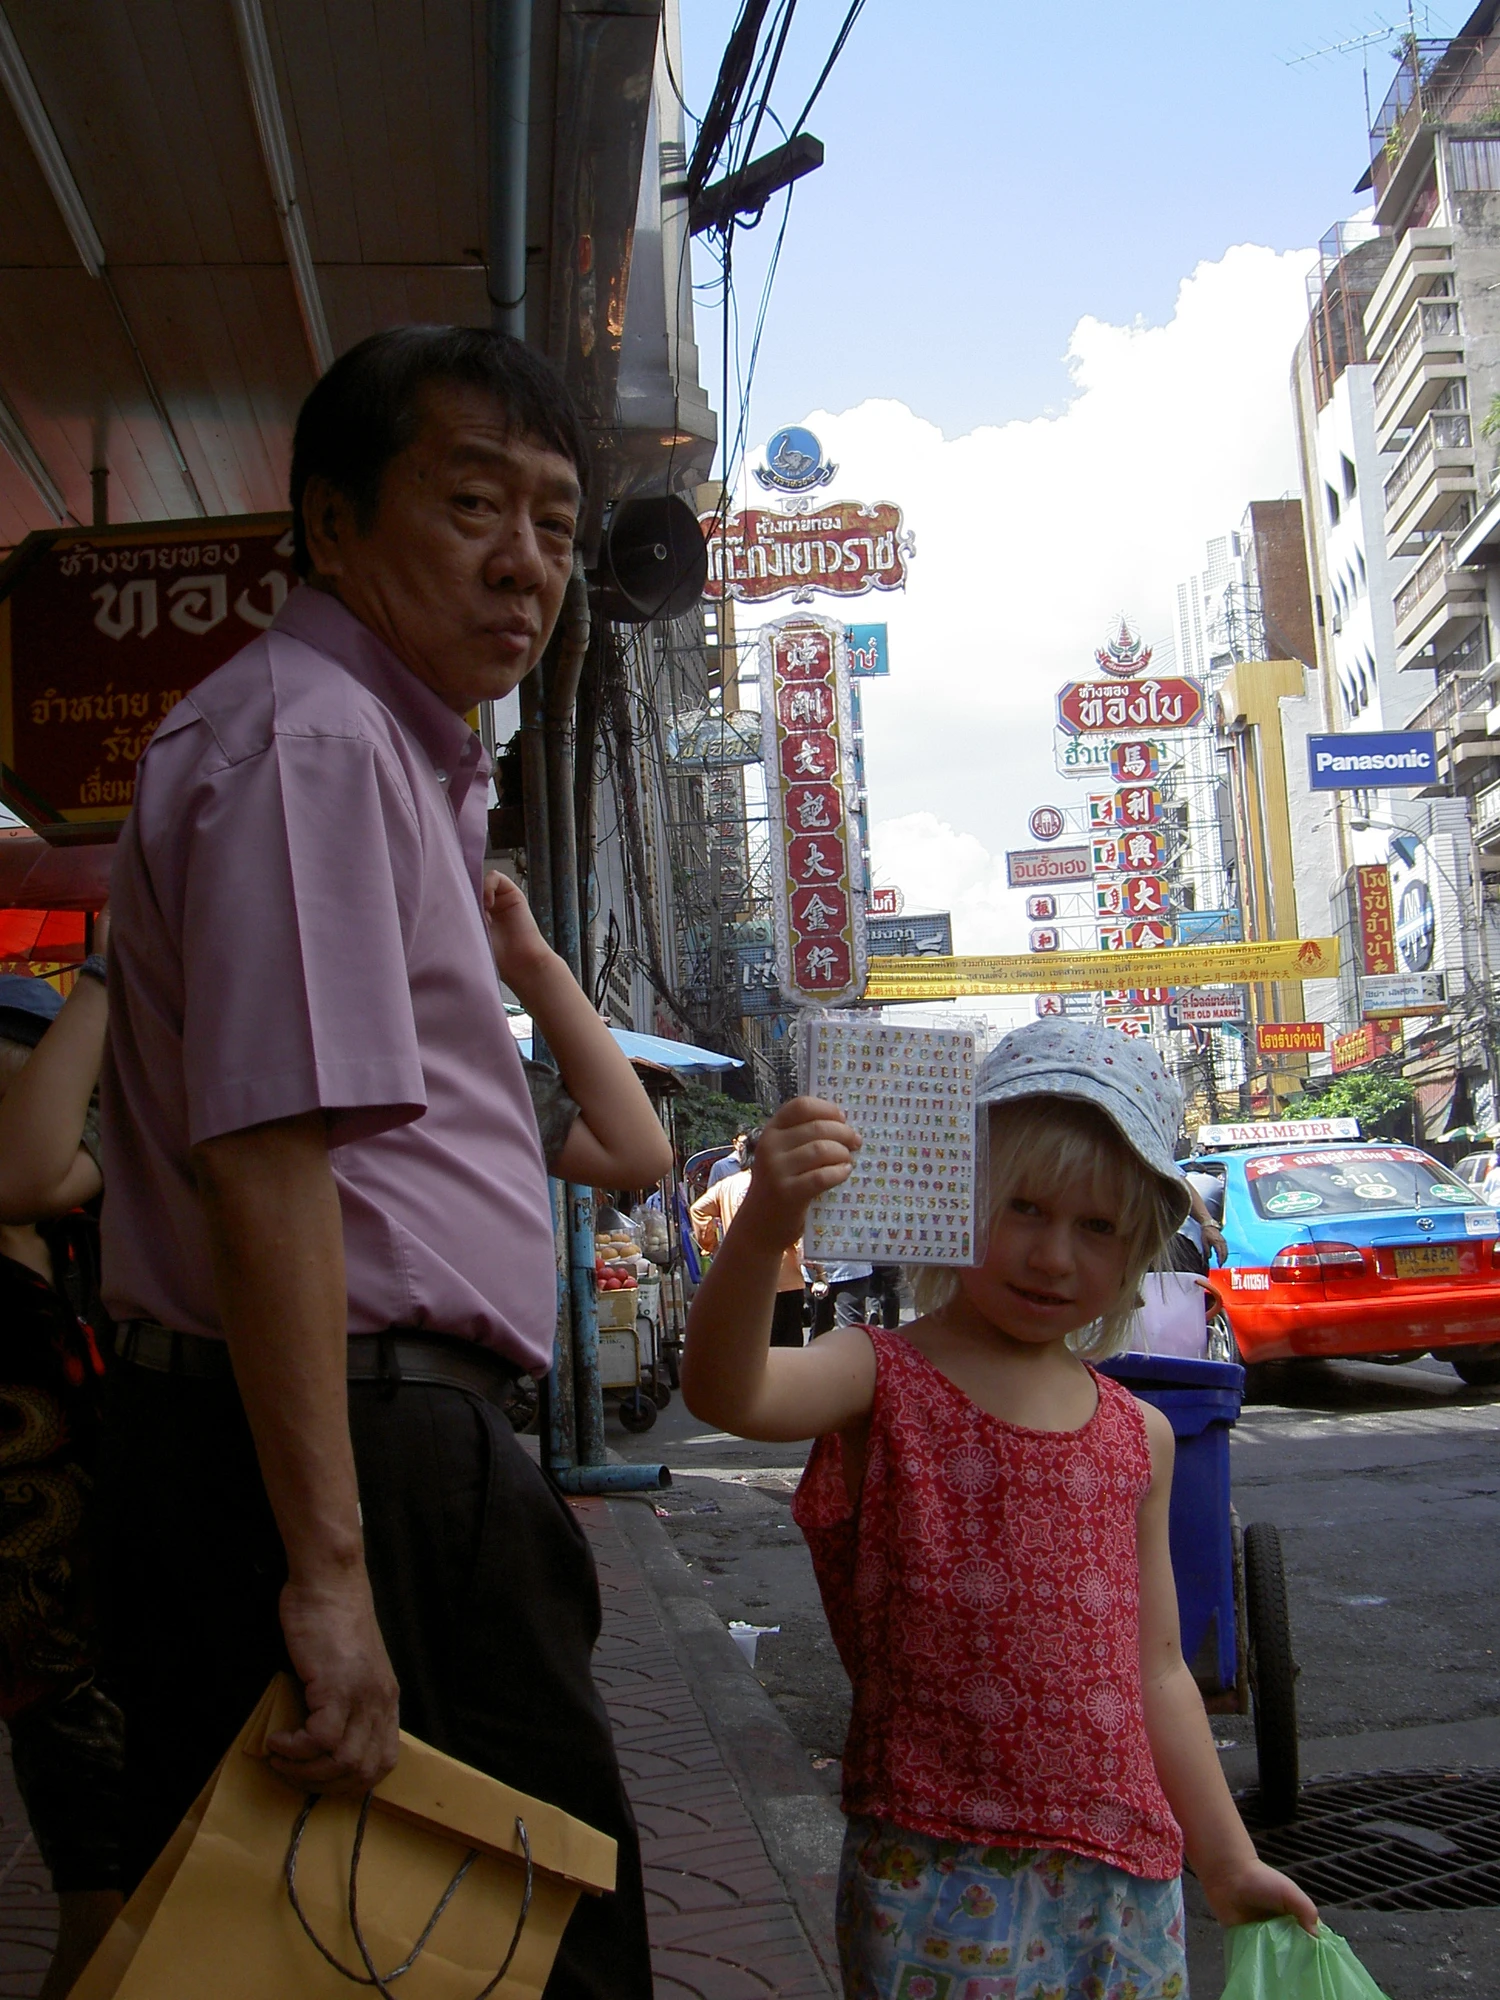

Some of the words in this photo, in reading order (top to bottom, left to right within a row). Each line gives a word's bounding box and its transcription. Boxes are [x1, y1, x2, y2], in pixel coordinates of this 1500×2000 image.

[756, 517, 841, 535] ห้างขายทอง
[60, 542, 240, 576] ห้างขายทอง
[91, 568, 291, 642] ทอง
[1079, 683, 1129, 698] ห้างทอง
[31, 682, 149, 724] จำหน่าย
[1079, 680, 1183, 727] ทองใบ
[1316, 748, 1431, 772] Panasonic
[1182, 1010, 1195, 1020] THE
[1197, 1010, 1211, 1019] OLD
[1213, 1008, 1241, 1018] MARKET
[1259, 1025, 1322, 1049] โรงรับจำนำ
[1228, 1122, 1334, 1141] TAXI-METER
[1330, 1172, 1389, 1187] 3111
